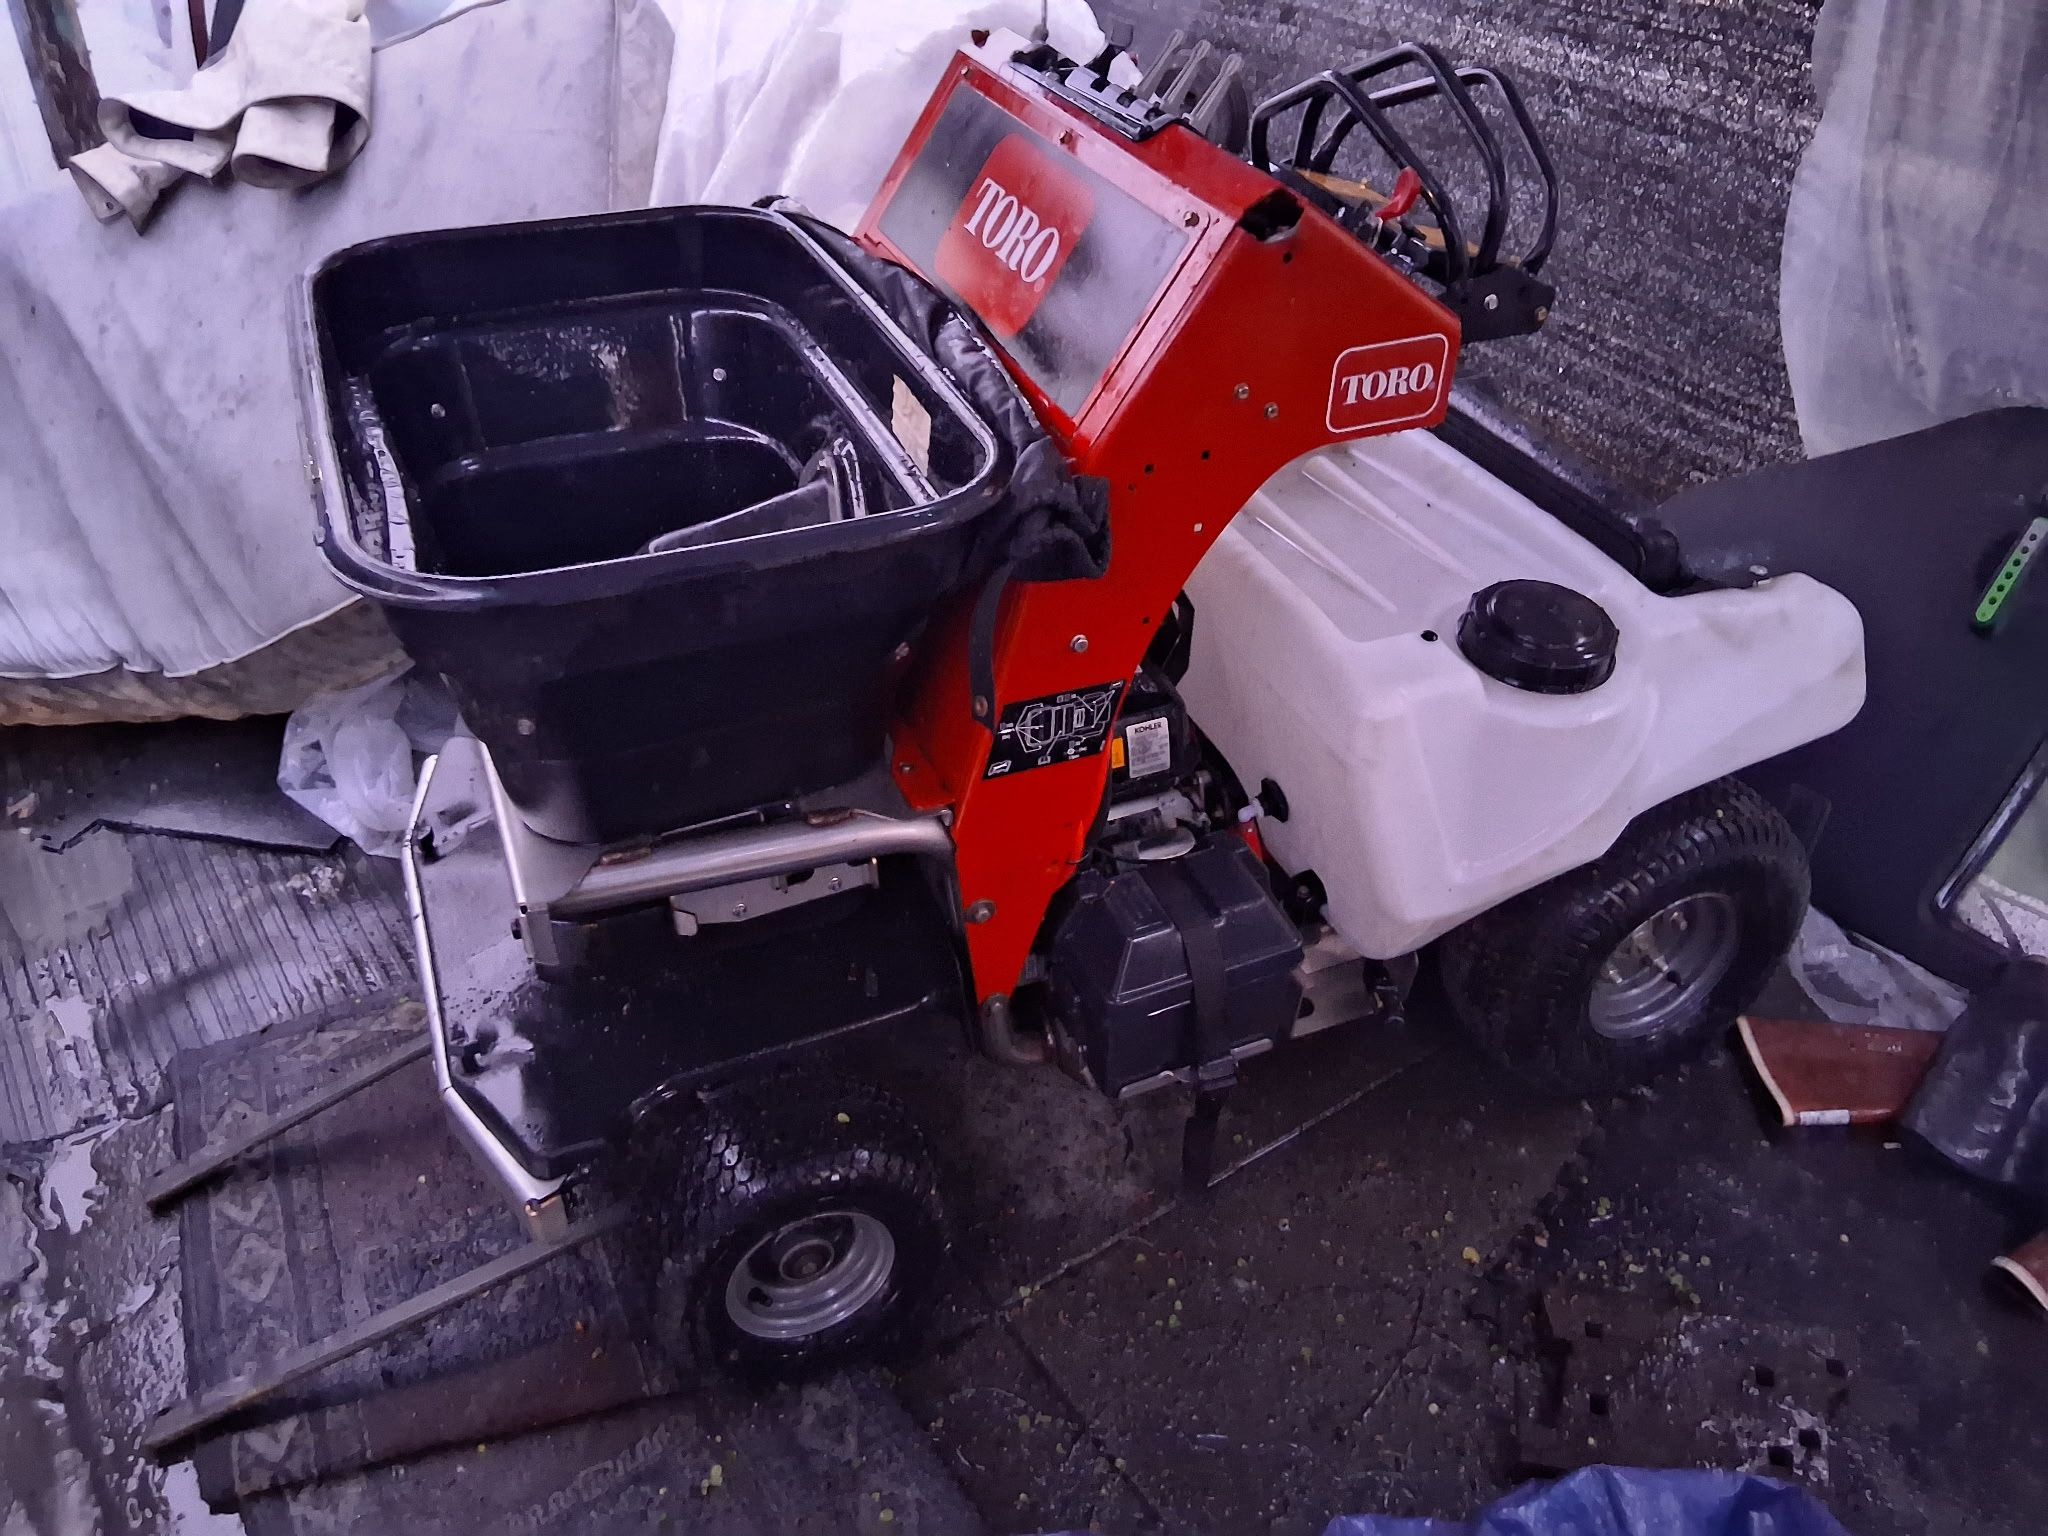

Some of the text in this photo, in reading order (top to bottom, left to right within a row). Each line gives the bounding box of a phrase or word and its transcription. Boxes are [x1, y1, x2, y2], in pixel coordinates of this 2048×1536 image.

[963, 177, 1060, 283] TORO
[1340, 362, 1434, 405] TORO
[1134, 721, 1162, 734] KOHLER
